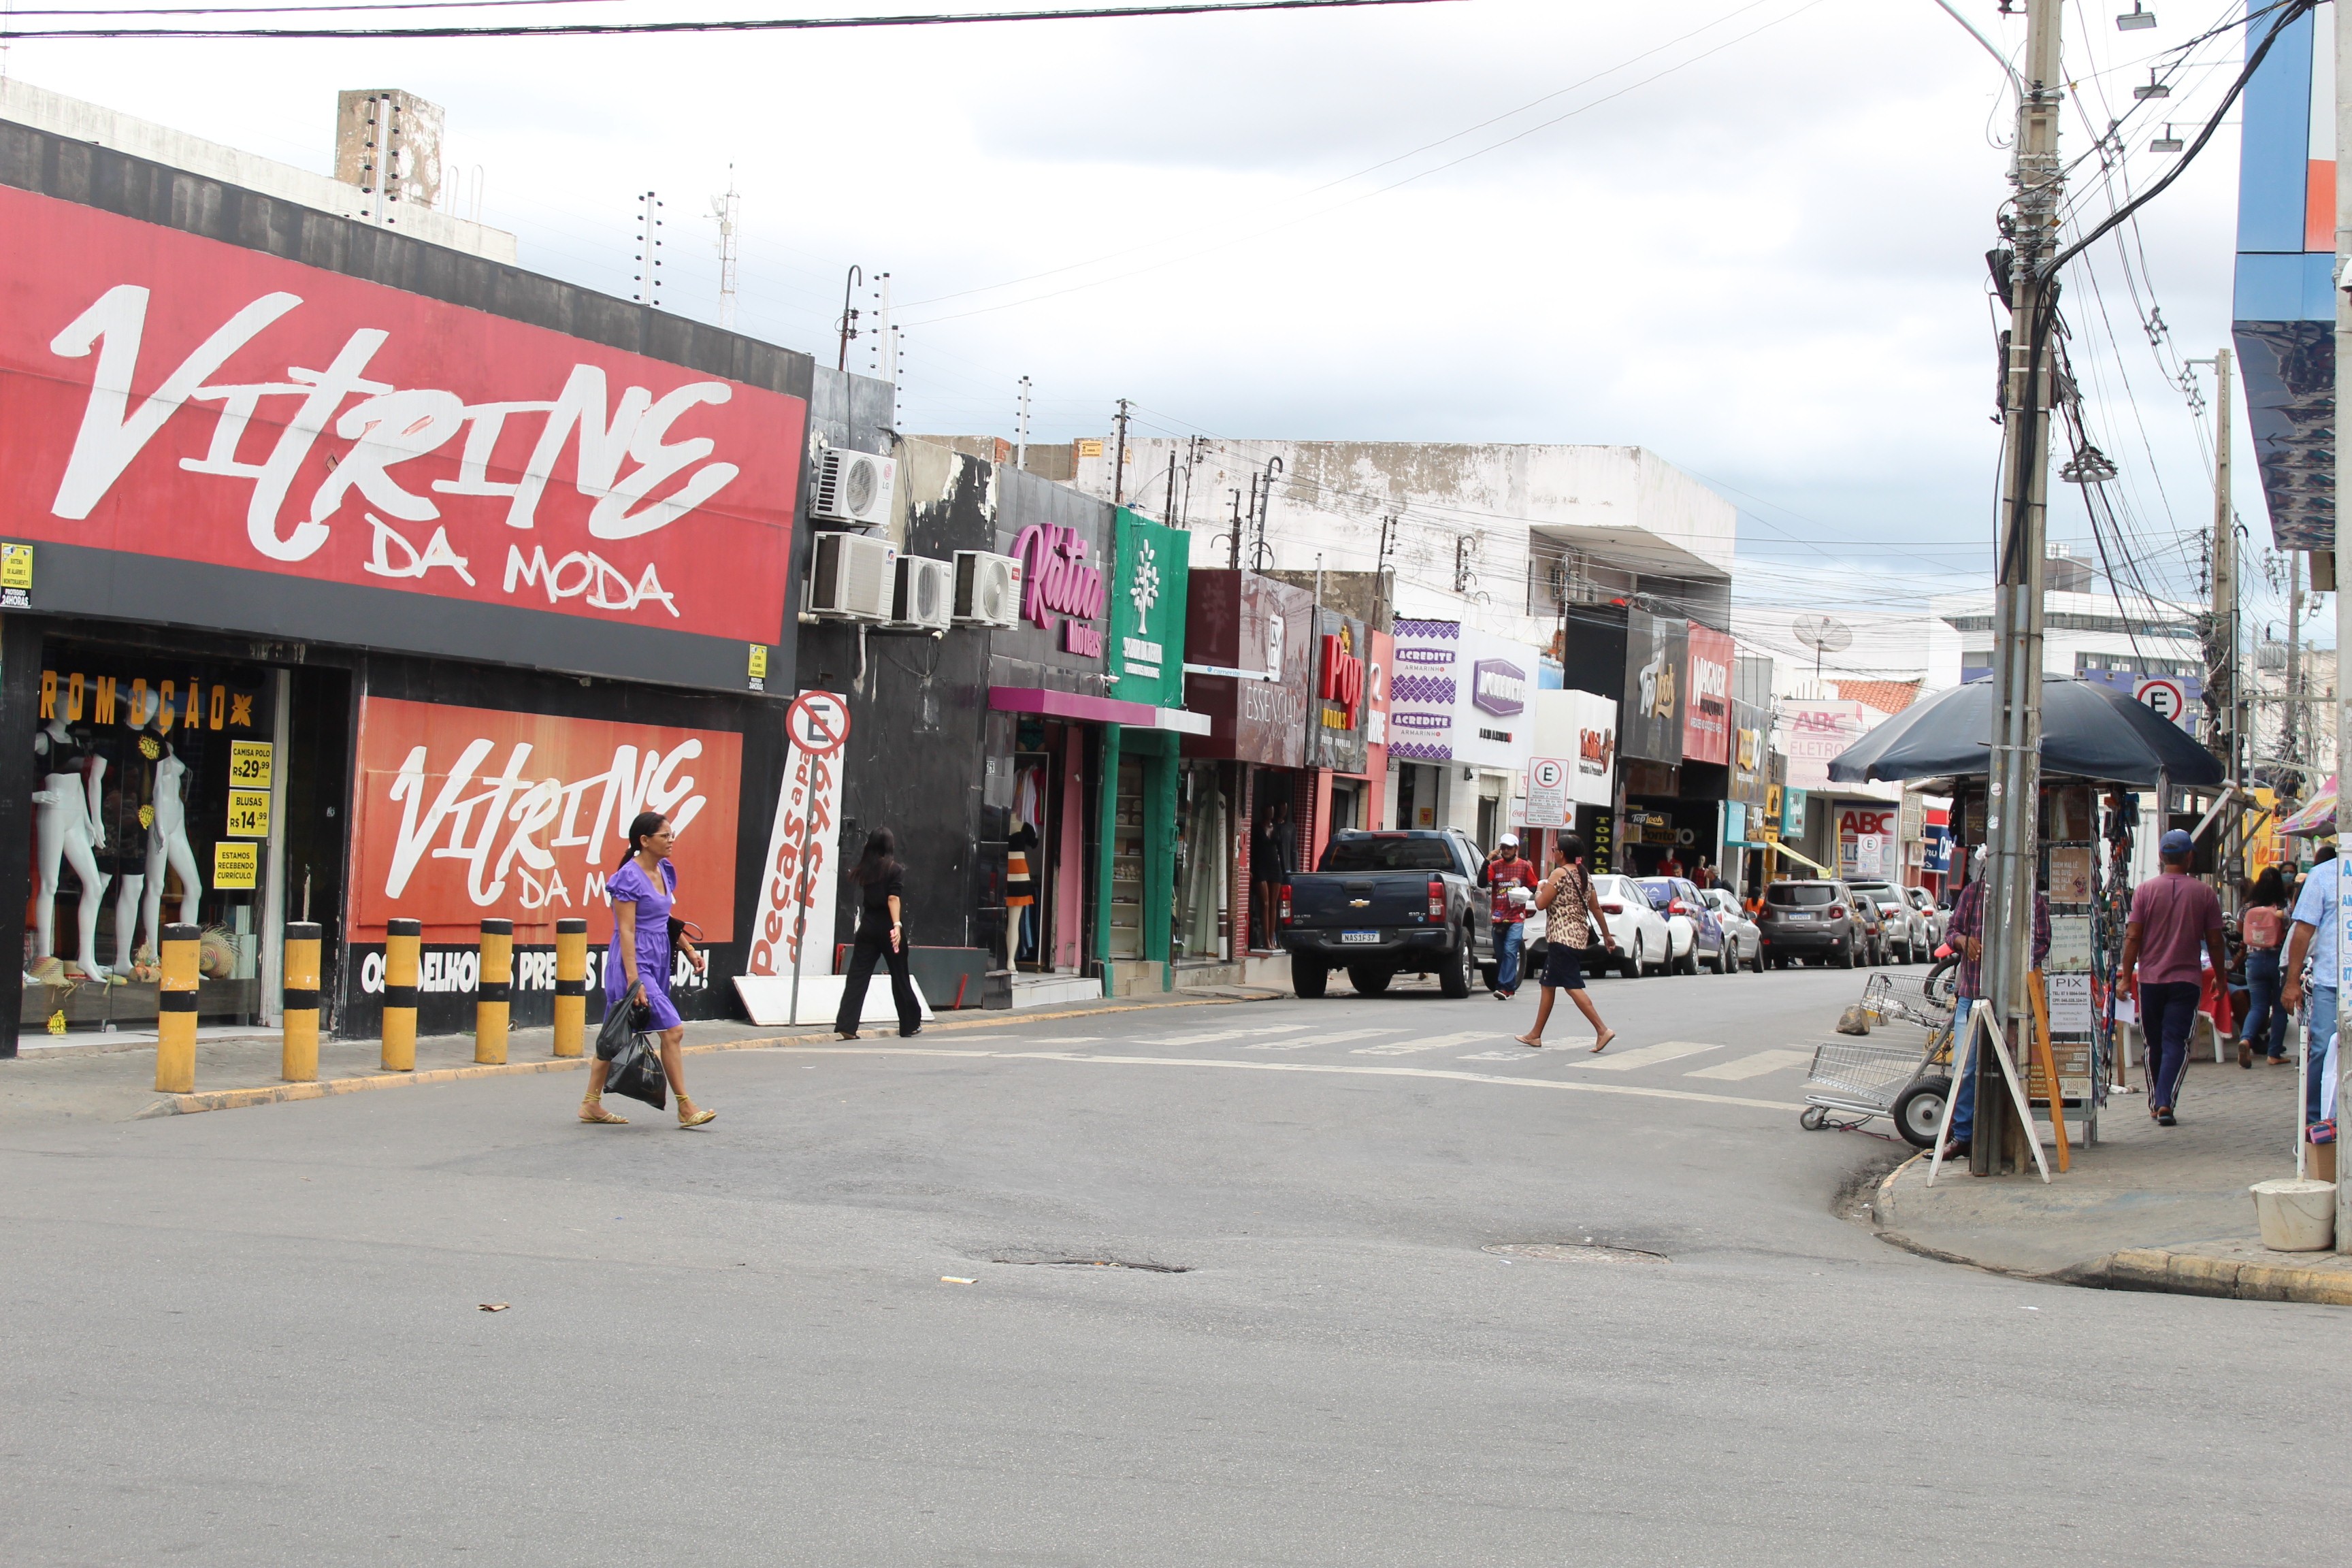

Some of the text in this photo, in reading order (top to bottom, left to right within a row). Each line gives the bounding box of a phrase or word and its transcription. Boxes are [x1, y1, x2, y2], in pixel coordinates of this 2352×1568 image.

[364, 512, 679, 617] DA MODA
[5, 588, 26, 597] PROTEGIDO
[1066, 620, 1101, 658] Modas
[1399, 650, 1452, 662] ACREDITE
[1213, 668, 1240, 676] camerite
[1693, 655, 1726, 706] WAGNER
[2150, 692, 2168, 715] E
[807, 704, 830, 741] E
[1394, 715, 1448, 726] ACREDITE
[1793, 710, 1846, 734] ABC
[233, 748, 270, 757] CAMISA POLO
[1791, 741, 1844, 757] ELETRO
[1544, 767, 1553, 781] E
[236, 797, 262, 806] BLUSAS
[1632, 813, 1649, 822] Top
[1840, 811, 1894, 835] ABC
[1867, 839, 1873, 848] E
[217, 871, 252, 879] CURRÍCULO.
[518, 866, 572, 909] DA
[1345, 934, 1375, 942] NAS1F37
[2056, 978, 2082, 987] PIX
[2061, 1080, 2065, 1089] A
